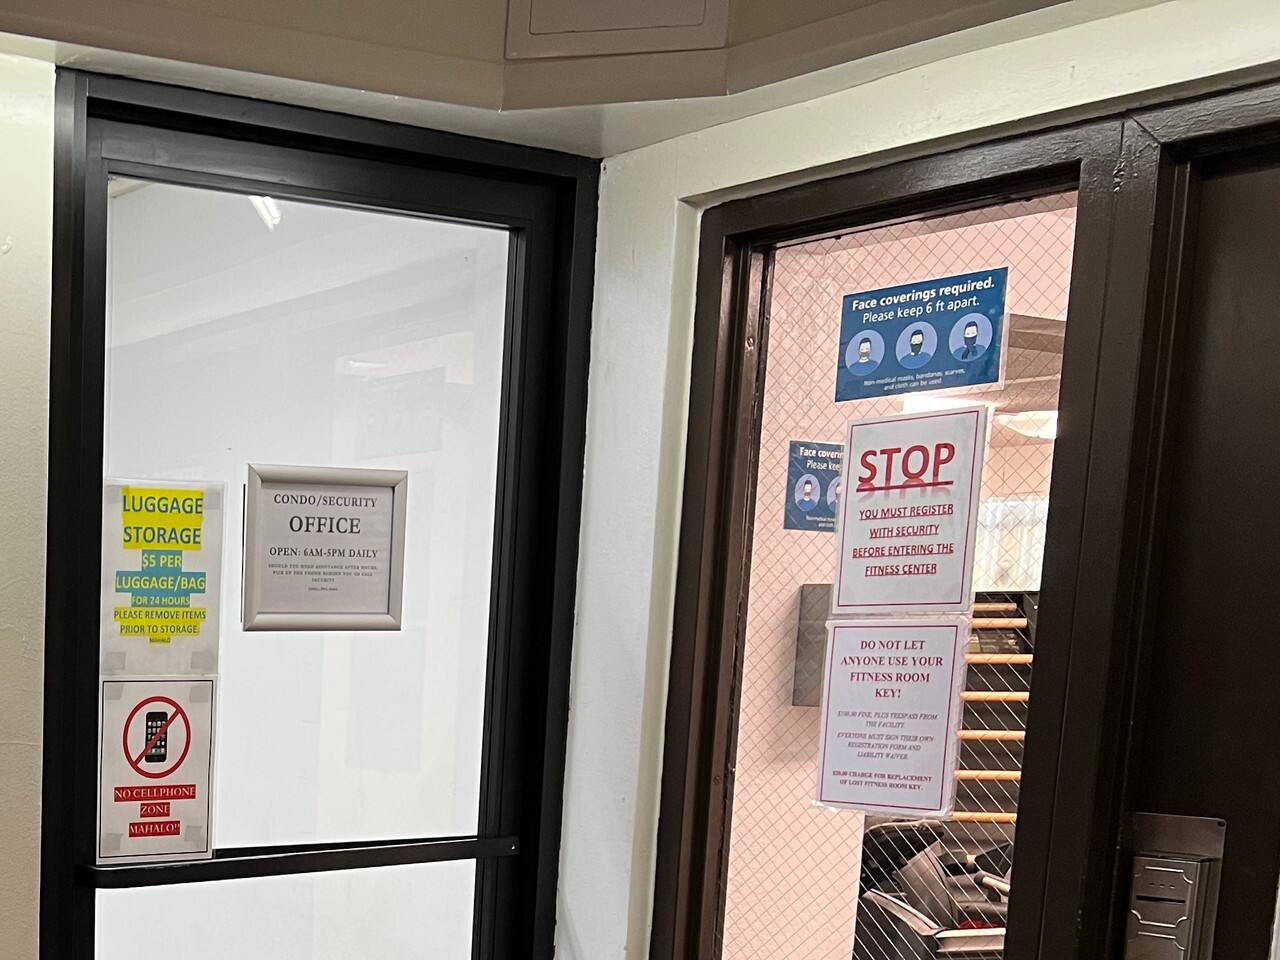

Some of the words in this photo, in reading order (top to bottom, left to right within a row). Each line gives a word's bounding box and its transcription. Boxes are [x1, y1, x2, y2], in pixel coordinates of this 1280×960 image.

[852, 300, 877, 311] Face
[880, 290, 936, 306] coverings
[939, 277, 995, 296] required.
[862, 312, 894, 323] Please
[897, 306, 923, 318] keep
[926, 302, 932, 313] 6
[936, 300, 945, 312] ft
[947, 296, 979, 311] apart.
[800, 447, 816, 457] Face
[807, 460, 827, 469] Please
[859, 443, 955, 483] STOP
[123, 495, 203, 514] LUGGAGE
[274, 494, 377, 507] CONDO/SECURITY
[859, 509, 879, 519] YOU
[881, 507, 907, 518] MUST
[910, 504, 953, 516] REGISTER
[290, 516, 361, 534] OFFICE
[123, 526, 201, 544] STORAGE
[870, 527, 893, 538] WITH
[896, 525, 939, 537] SECURITY
[269, 547, 301, 556] OPEN:
[304, 548, 345, 557] 6AM-5PM
[349, 549, 378, 558] DAILY
[853, 546, 885, 558] BEFORE
[888, 544, 933, 556] ENTERING
[937, 543, 954, 554] THE
[143, 554, 156, 568] $5
[160, 556, 181, 567] PER
[865, 565, 900, 576] FITNESS
[903, 564, 936, 575] CENTER
[115, 576, 205, 591] LUGGAGE/BAG
[132, 596, 148, 605] FOR
[150, 596, 160, 605] 24
[162, 596, 190, 606] HOURS
[114, 610, 143, 619] PLEASE
[145, 611, 179, 620] REMOVE
[182, 611, 206, 619] ITEMS
[120, 625, 144, 633] PRIOR
[148, 625, 158, 633] TO
[161, 625, 199, 634] STORAGE.
[860, 640, 875, 650] DO
[878, 641, 901, 650] NOT
[904, 641, 926, 649] LET
[841, 656, 884, 665] ANYONE
[889, 657, 908, 665] USE
[912, 657, 943, 666] YOUR
[850, 672, 892, 682] FITNESS
[895, 673, 930, 682] ROOM
[875, 689, 901, 698] KEY!
[115, 789, 131, 798] NO
[141, 805, 169, 814] ZONE
